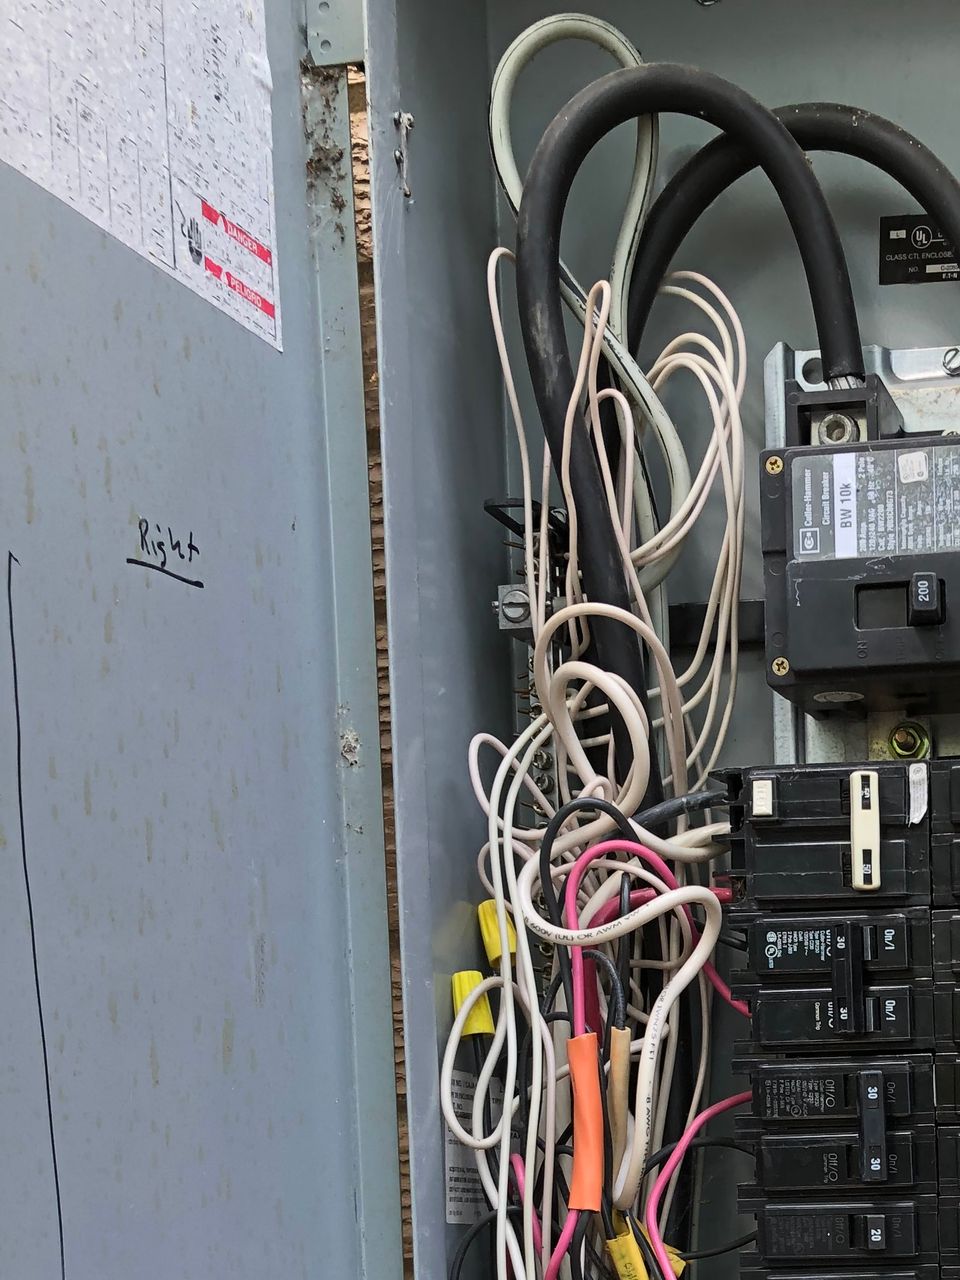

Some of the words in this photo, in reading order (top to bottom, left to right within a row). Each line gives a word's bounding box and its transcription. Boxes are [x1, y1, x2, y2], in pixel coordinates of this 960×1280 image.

[227, 225, 258, 255] DANGER
[916, 230, 928, 244] UL
[231, 278, 262, 307] PELIGRO
[821, 471, 830, 499] Breaker
[839, 482, 851, 503] 10k
[803, 468, 812, 526] Cutler-Hammer
[822, 500, 830, 525] Circuit
[840, 508, 852, 528] BW
[138, 518, 200, 568] Right
[887, 534, 895, 550] Style
[918, 580, 930, 602] 200
[856, 640, 868, 658] ON
[863, 864, 871, 874] 50
[596, 921, 622, 936] AWM
[837, 936, 845, 949] 30
[840, 1007, 848, 1020] 30
[867, 1086, 877, 1099] 30
[870, 1157, 880, 1171] 30
[870, 1228, 881, 1242] 20
